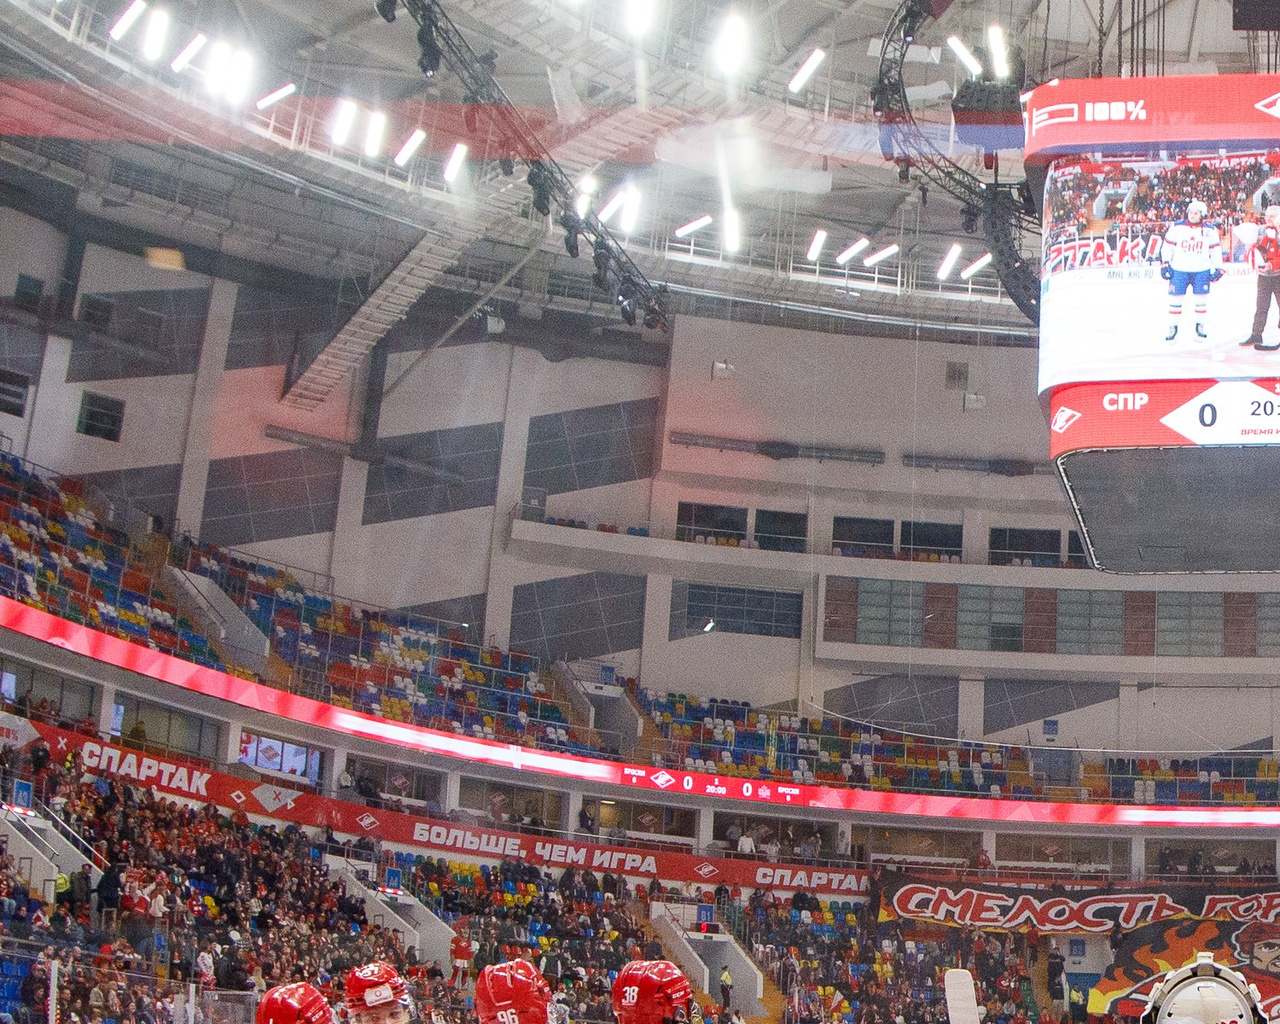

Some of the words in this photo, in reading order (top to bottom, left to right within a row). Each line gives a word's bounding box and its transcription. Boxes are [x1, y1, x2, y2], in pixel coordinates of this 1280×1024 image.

[1084, 99, 1147, 121] 100%
[1103, 392, 1149, 411] СПР
[1199, 403, 1217, 427] 0
[1240, 427, 1273, 436] ВРЕМЯ
[82, 742, 212, 797] СПАРТАК
[682, 776, 693, 790] 0
[706, 785, 727, 795] 20:00
[742, 783, 752, 796] 0
[413, 823, 527, 857] БОЛЬШЕ,
[534, 843, 587, 866] ЧЕМ
[592, 850, 657, 874] ИГРА
[893, 883, 1190, 931] СМЕЛОСТЬ
[622, 986, 639, 1006] 38
